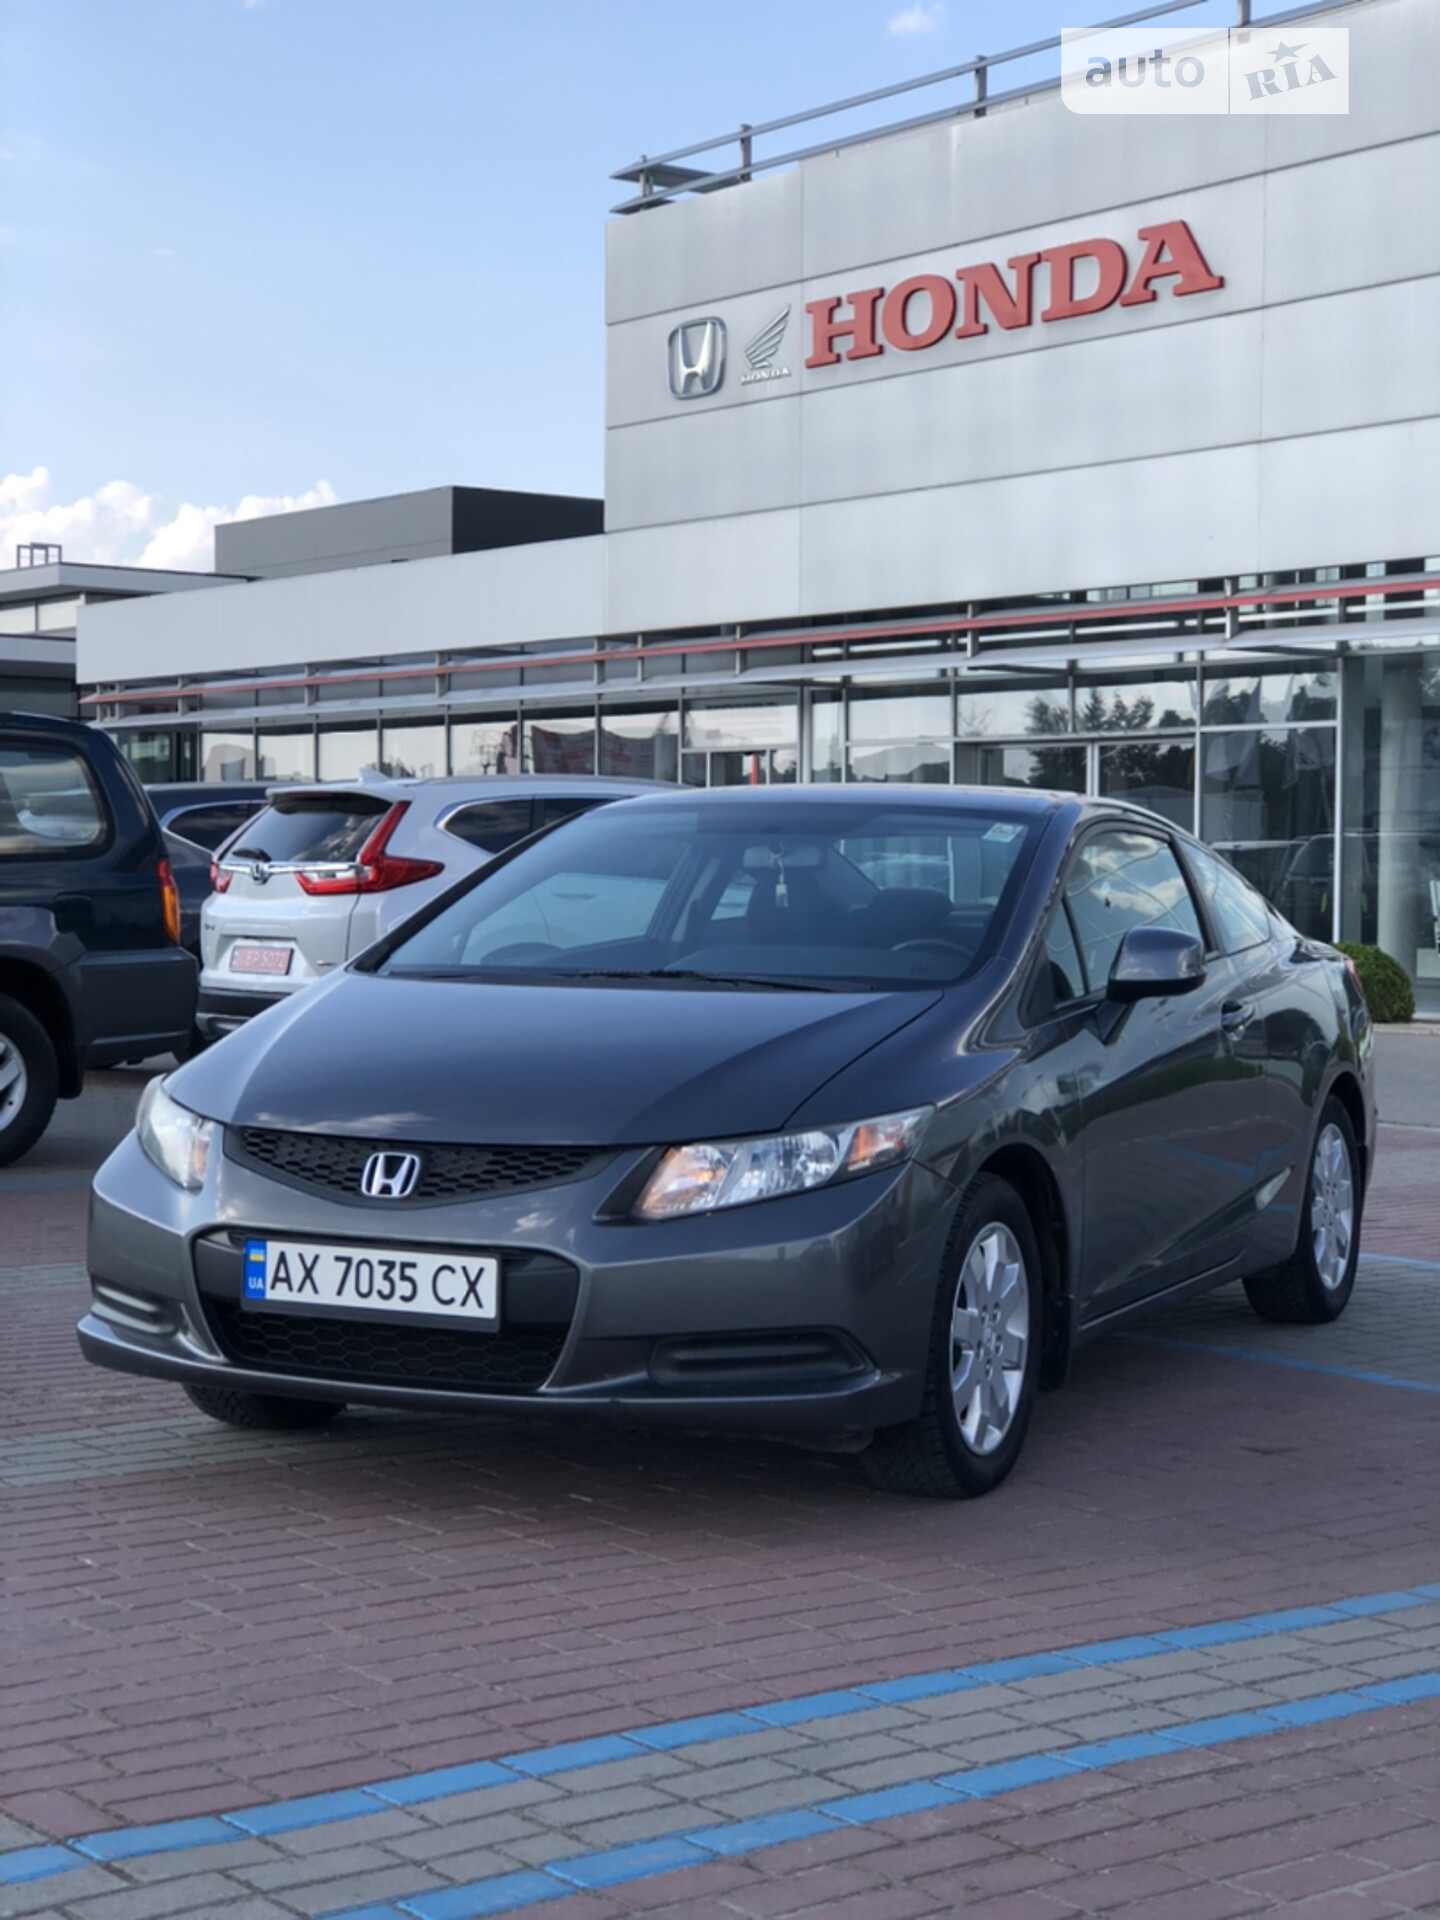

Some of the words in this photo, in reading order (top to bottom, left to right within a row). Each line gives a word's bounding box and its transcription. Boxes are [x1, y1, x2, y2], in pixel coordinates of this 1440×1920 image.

[804, 219, 1225, 369] HONDA
[740, 366, 791, 386] HONDA
[248, 1275, 265, 1290] UA
[269, 1250, 320, 1296] AX
[333, 1255, 418, 1303] 7035
[431, 1264, 486, 1309] CX
